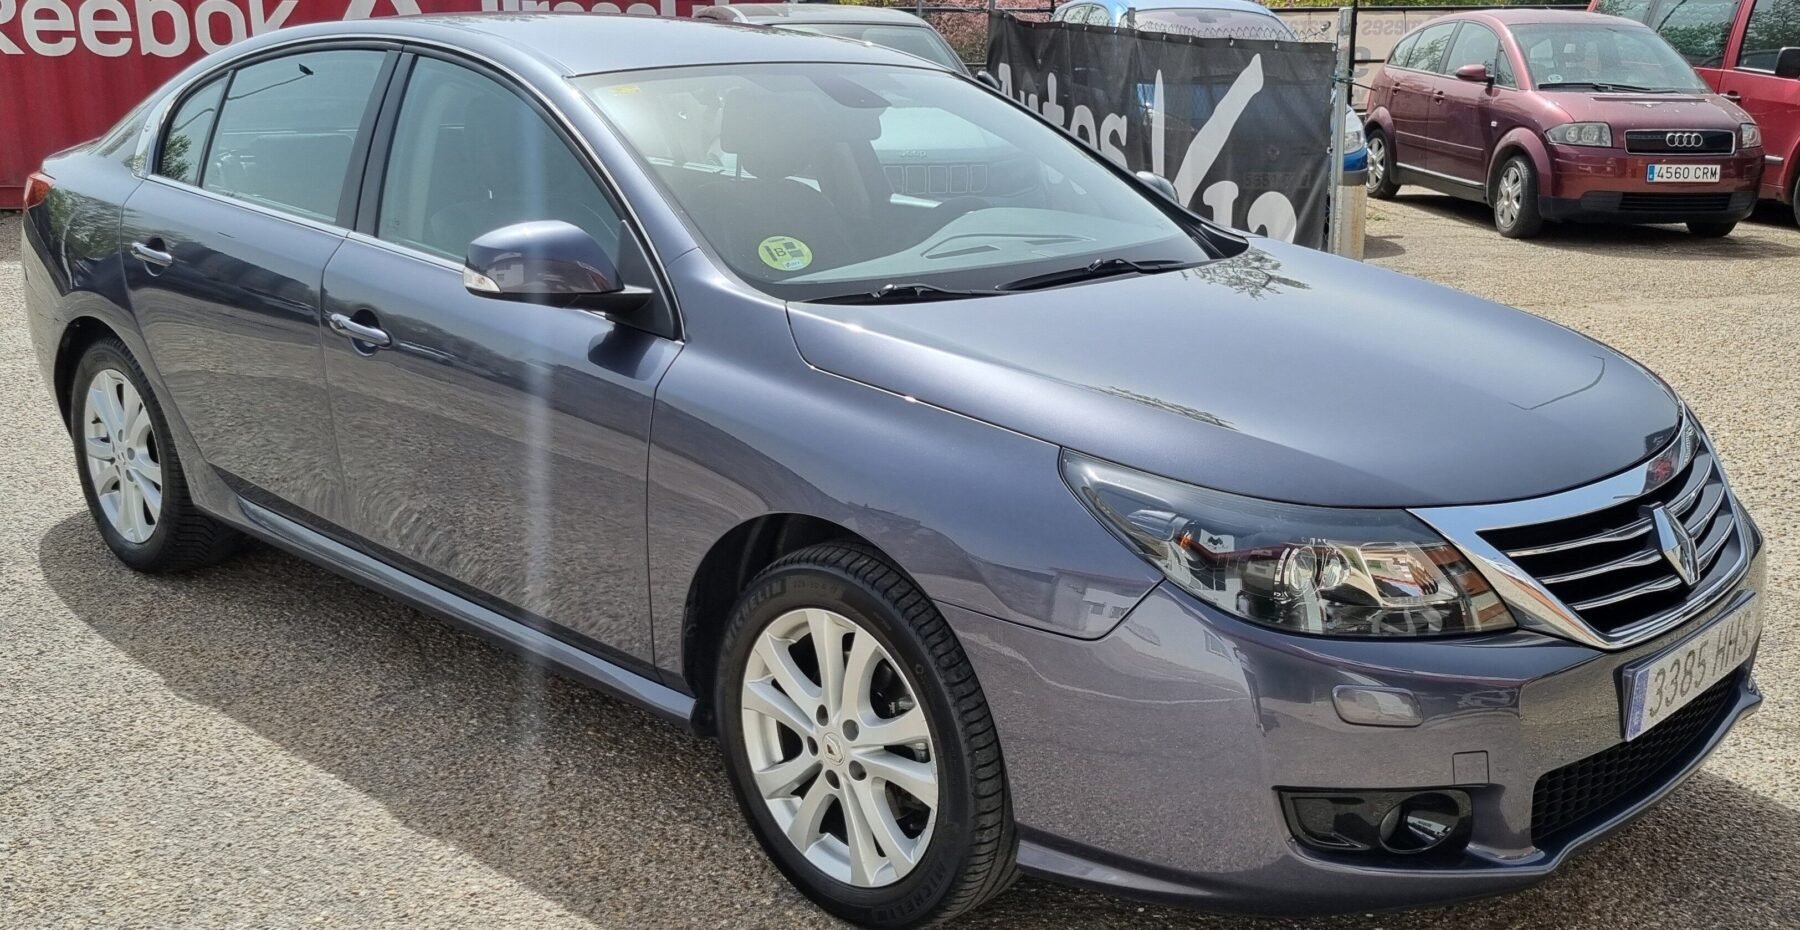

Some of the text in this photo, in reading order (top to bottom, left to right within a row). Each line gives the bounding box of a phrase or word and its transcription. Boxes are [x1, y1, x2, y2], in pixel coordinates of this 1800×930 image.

[1657, 167, 1717, 179] 4560 CRM
[774, 247, 786, 257] B
[1649, 639, 1709, 718] 3385
